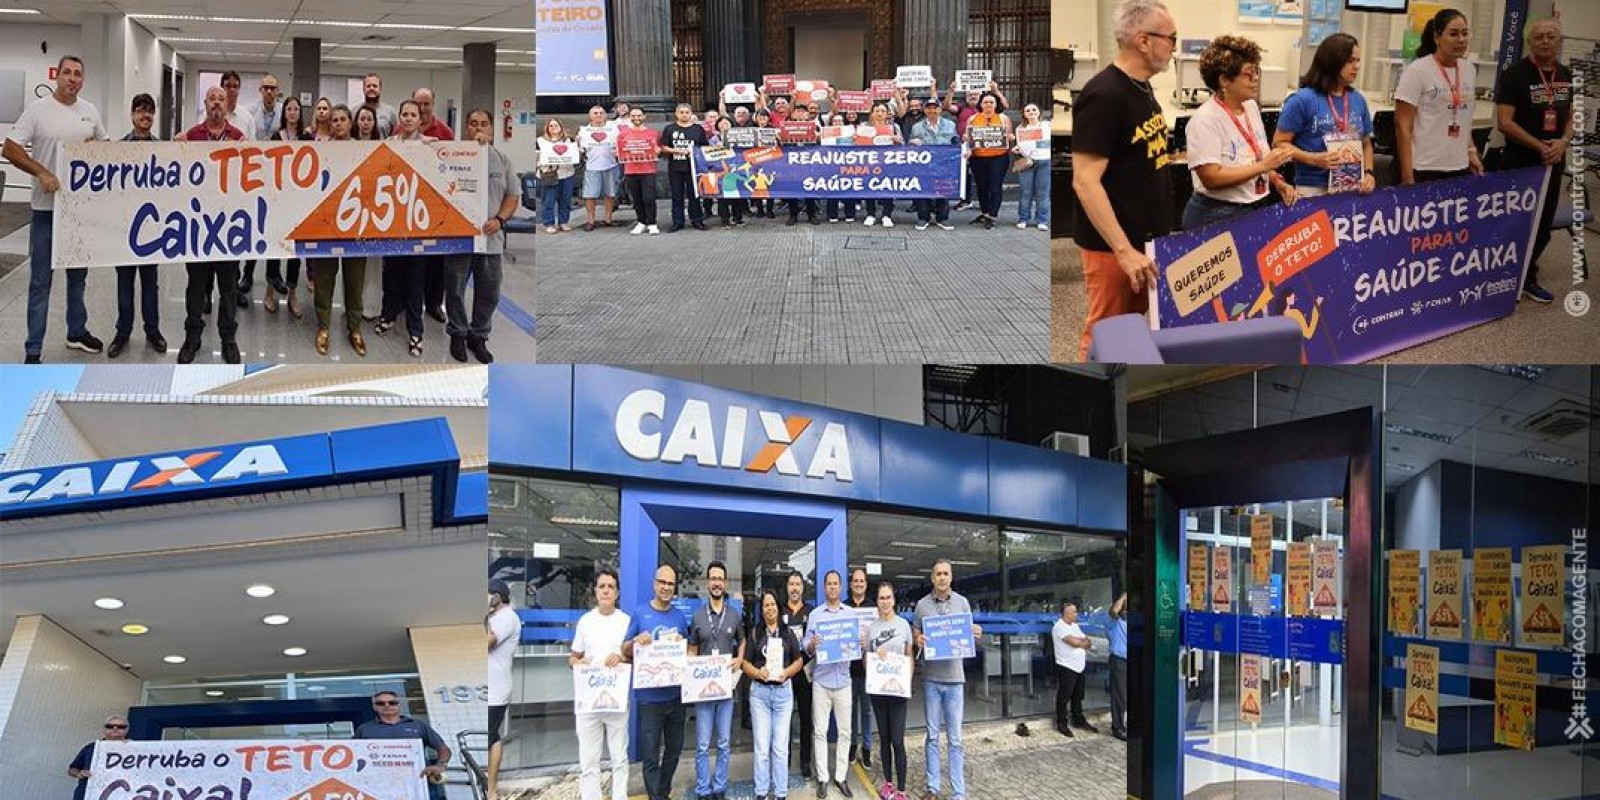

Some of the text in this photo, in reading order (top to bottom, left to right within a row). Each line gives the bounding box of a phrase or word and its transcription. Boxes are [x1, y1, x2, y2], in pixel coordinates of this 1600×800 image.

[69, 144, 331, 193] Derruba o TETO,
[788, 151, 880, 165] REAJUSTE
[884, 151, 932, 164] ZERO
[840, 166, 882, 175] PARA O
[336, 172, 430, 236] 6,5%
[802, 175, 922, 191] SAÚDE CAIXA
[129, 196, 267, 259] Caixa!
[1332, 188, 1537, 247] REAJUSTE ZERO
[1265, 221, 1321, 266] DERRUBA
[1275, 236, 1323, 276] O TETO!
[1411, 228, 1469, 254] PARA O
[1173, 245, 1233, 292] QUEREMOS
[1189, 269, 1226, 301] SAÚDE
[1355, 241, 1518, 302] SAÚDE CAIXA
[614, 388, 853, 483] CAIXA
[0, 444, 288, 503] CAIXA
[105, 749, 206, 769] Derruba
[213, 753, 230, 767] o
[235, 744, 366, 773] TETO,
